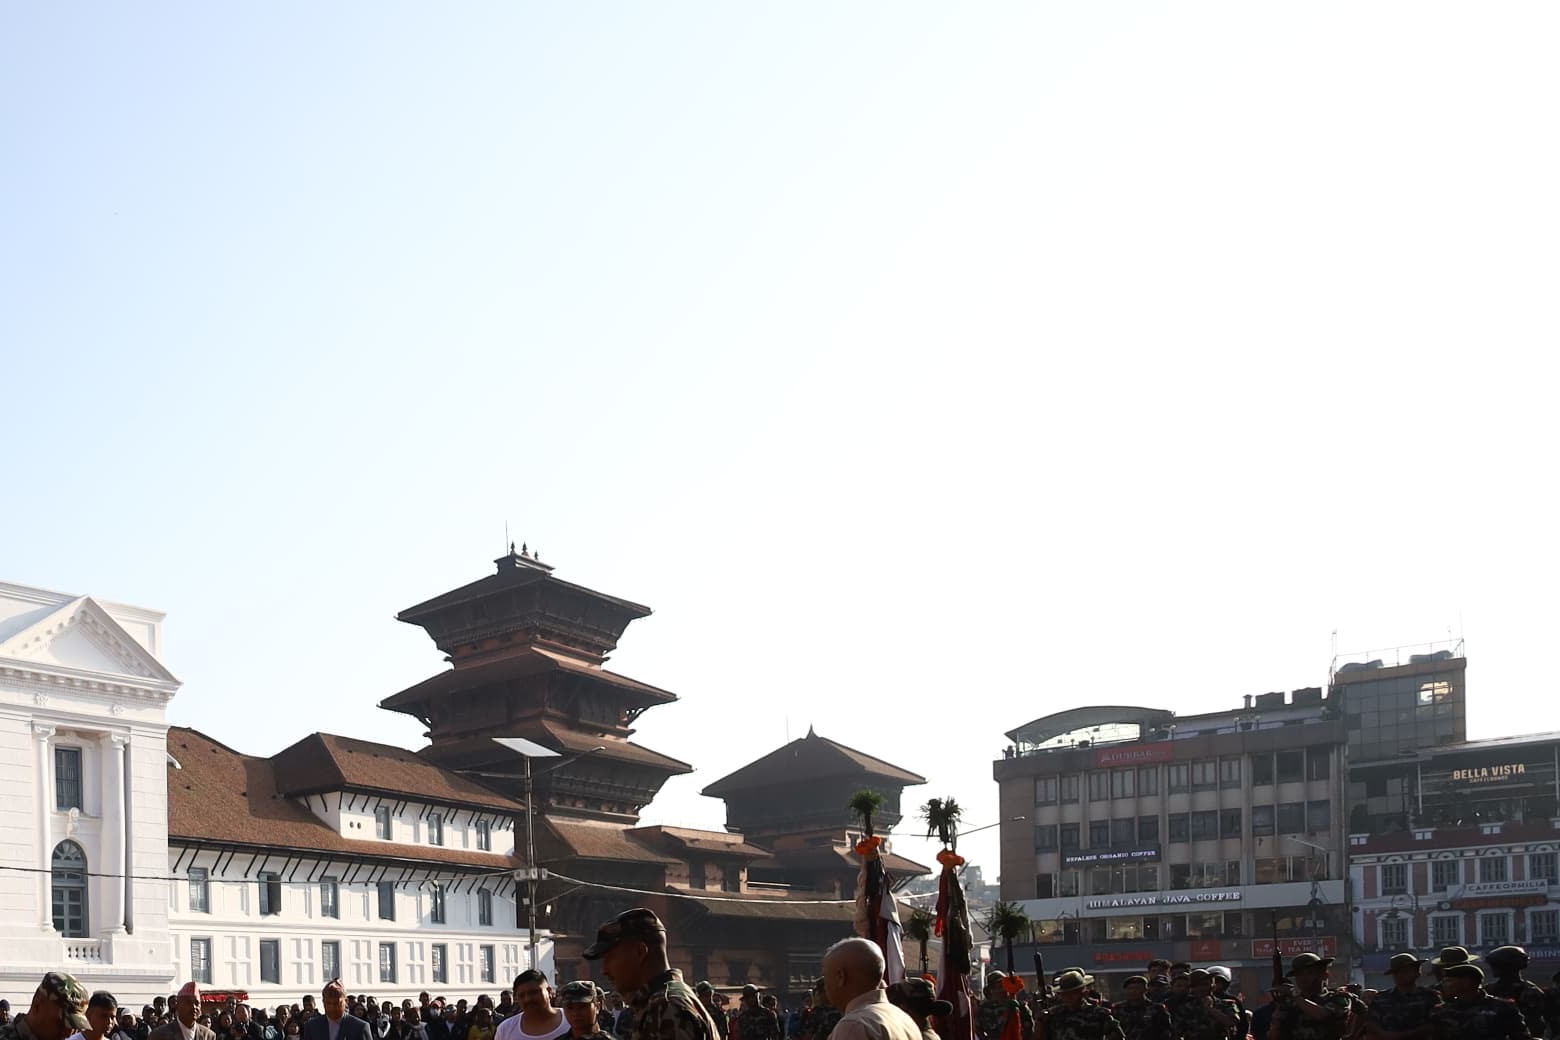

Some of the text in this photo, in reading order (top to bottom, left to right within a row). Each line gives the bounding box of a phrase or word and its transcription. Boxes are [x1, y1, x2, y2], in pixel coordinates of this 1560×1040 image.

[1453, 763, 1526, 780] BELLA VISTA
[1088, 891, 1241, 908] HIMALAYAN JAVA COFFEE
